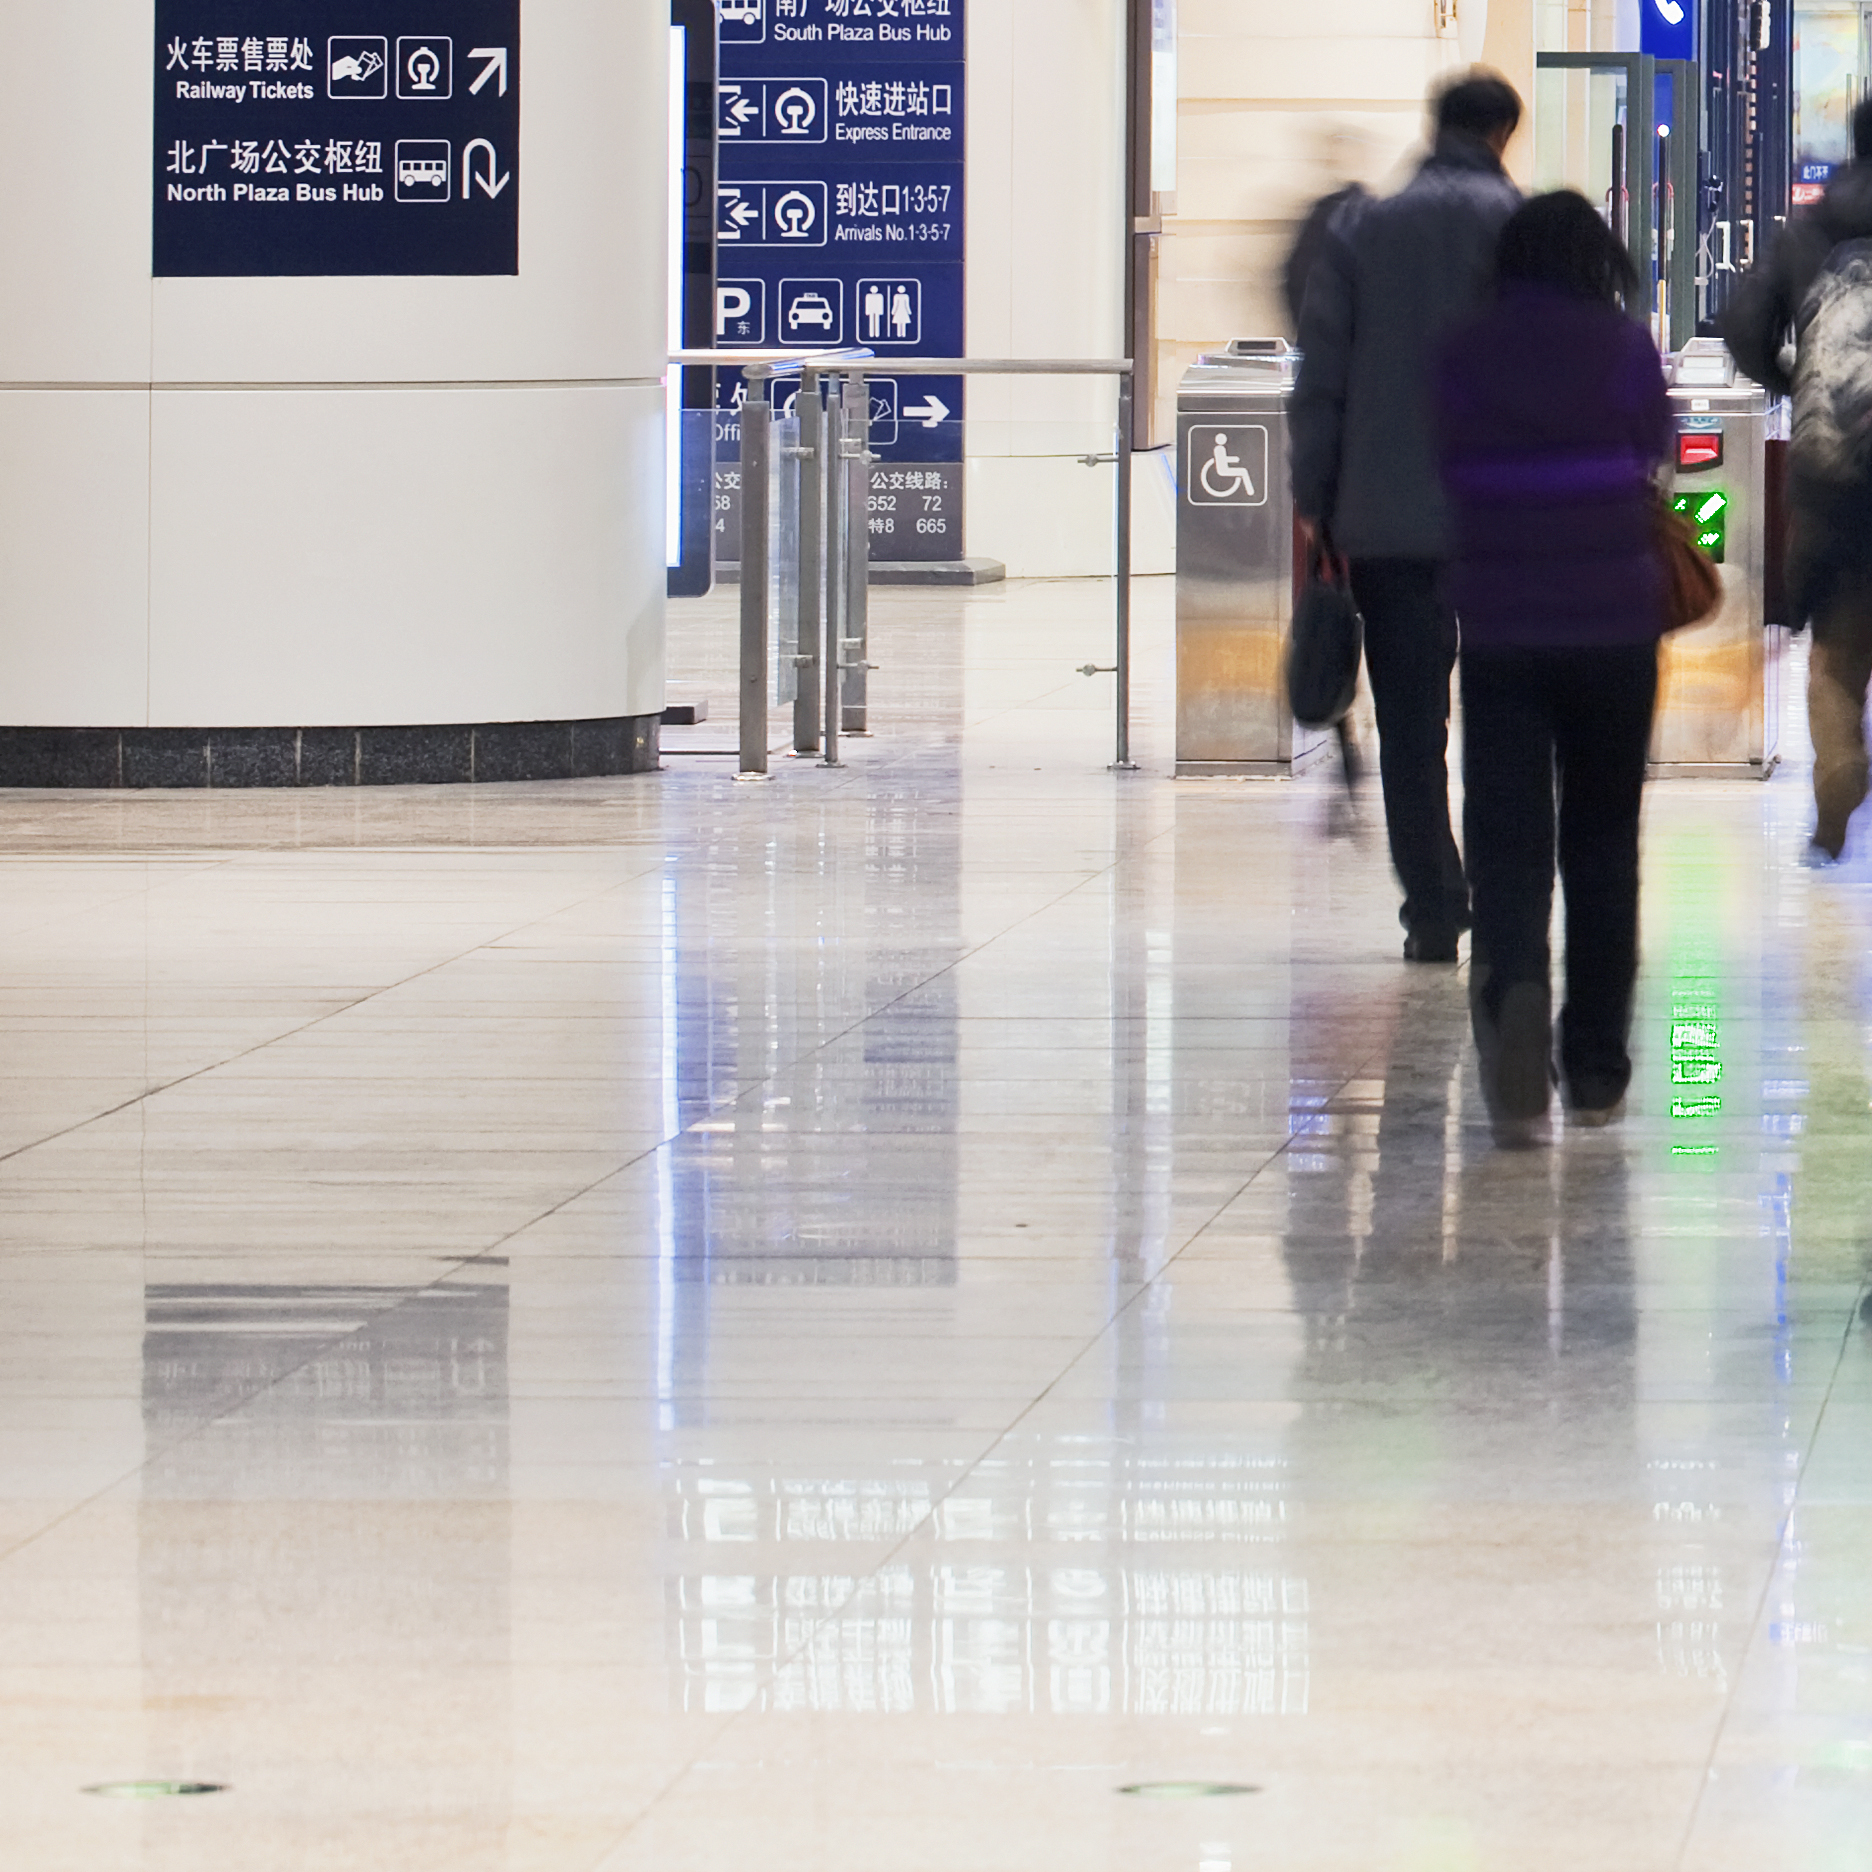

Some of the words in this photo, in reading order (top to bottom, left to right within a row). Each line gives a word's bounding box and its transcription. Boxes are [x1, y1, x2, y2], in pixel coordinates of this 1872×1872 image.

[774, 23, 822, 40] South
[828, 24, 873, 41] Plaza
[879, 24, 911, 41] Bus
[917, 24, 951, 41] Hub
[166, 36, 313, 72] 火车票售票处
[177, 81, 246, 103] Railway
[249, 81, 313, 99] Tickets
[836, 81, 951, 116] 快速进站口
[836, 123, 888, 144] Express
[893, 123, 951, 140] Entrance
[167, 139, 382, 174] 北广场公交枢纽
[168, 184, 226, 201] North
[234, 184, 289, 201] Plaza
[297, 184, 336, 201] Bus
[343, 184, 383, 201] Hub
[835, 224, 882, 241] Arrivals
[922, 496, 941, 511] 72
[916, 518, 946, 533] 665
